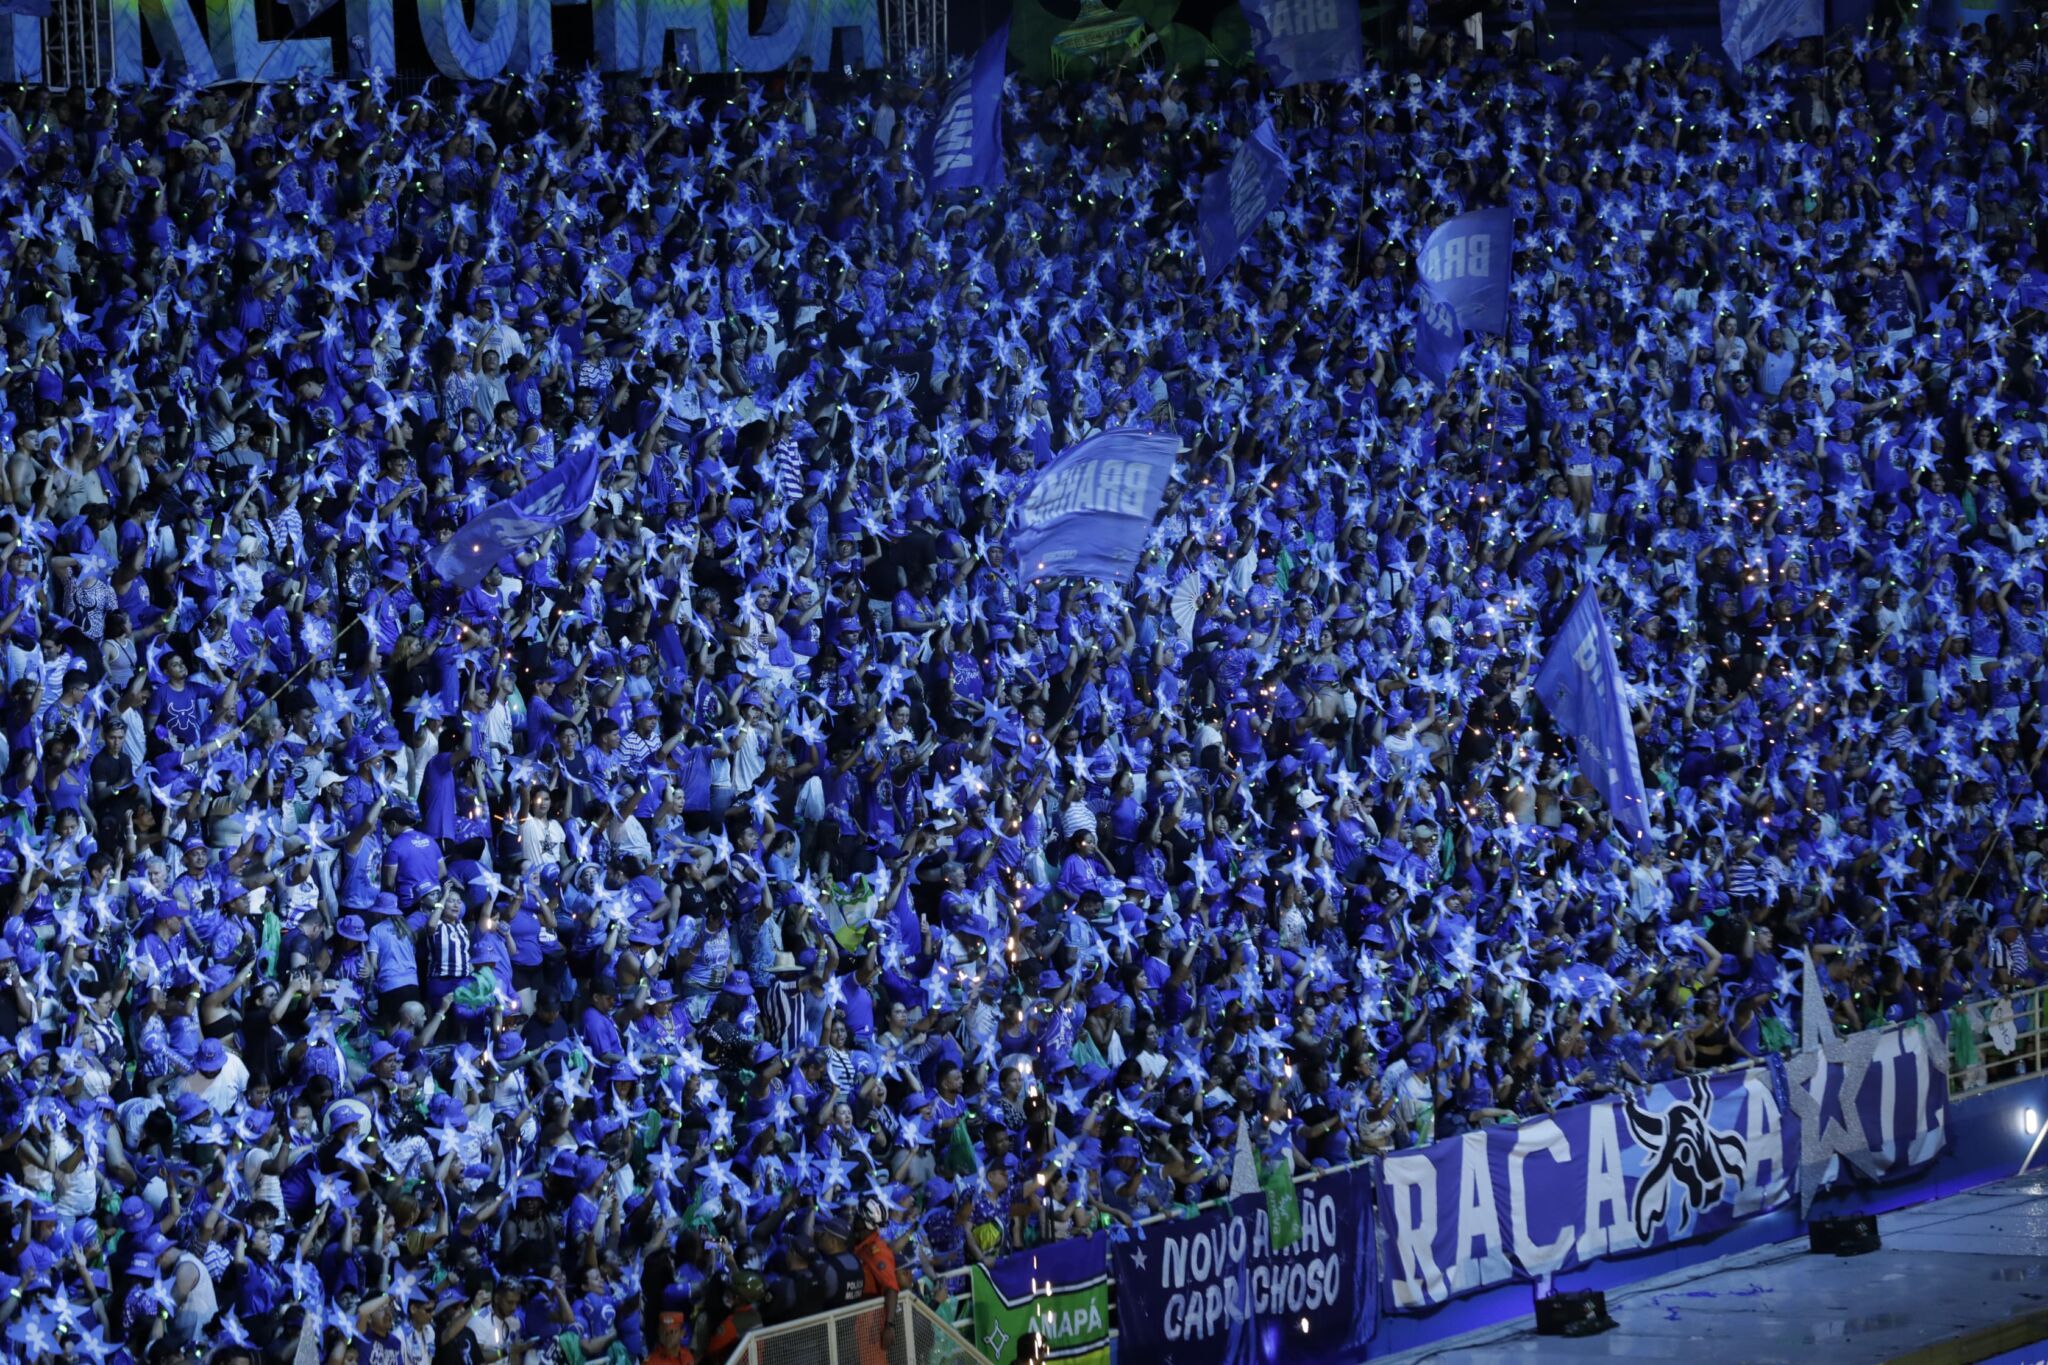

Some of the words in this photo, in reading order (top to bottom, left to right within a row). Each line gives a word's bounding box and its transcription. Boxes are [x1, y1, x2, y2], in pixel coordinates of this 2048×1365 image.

[1162, 1215, 1247, 1289] NOVO
[1252, 1187, 1337, 1259] AÃO
[1027, 1296, 1103, 1340] AMAPÁ
[1163, 1252, 1340, 1342] CAPRICHOSO
